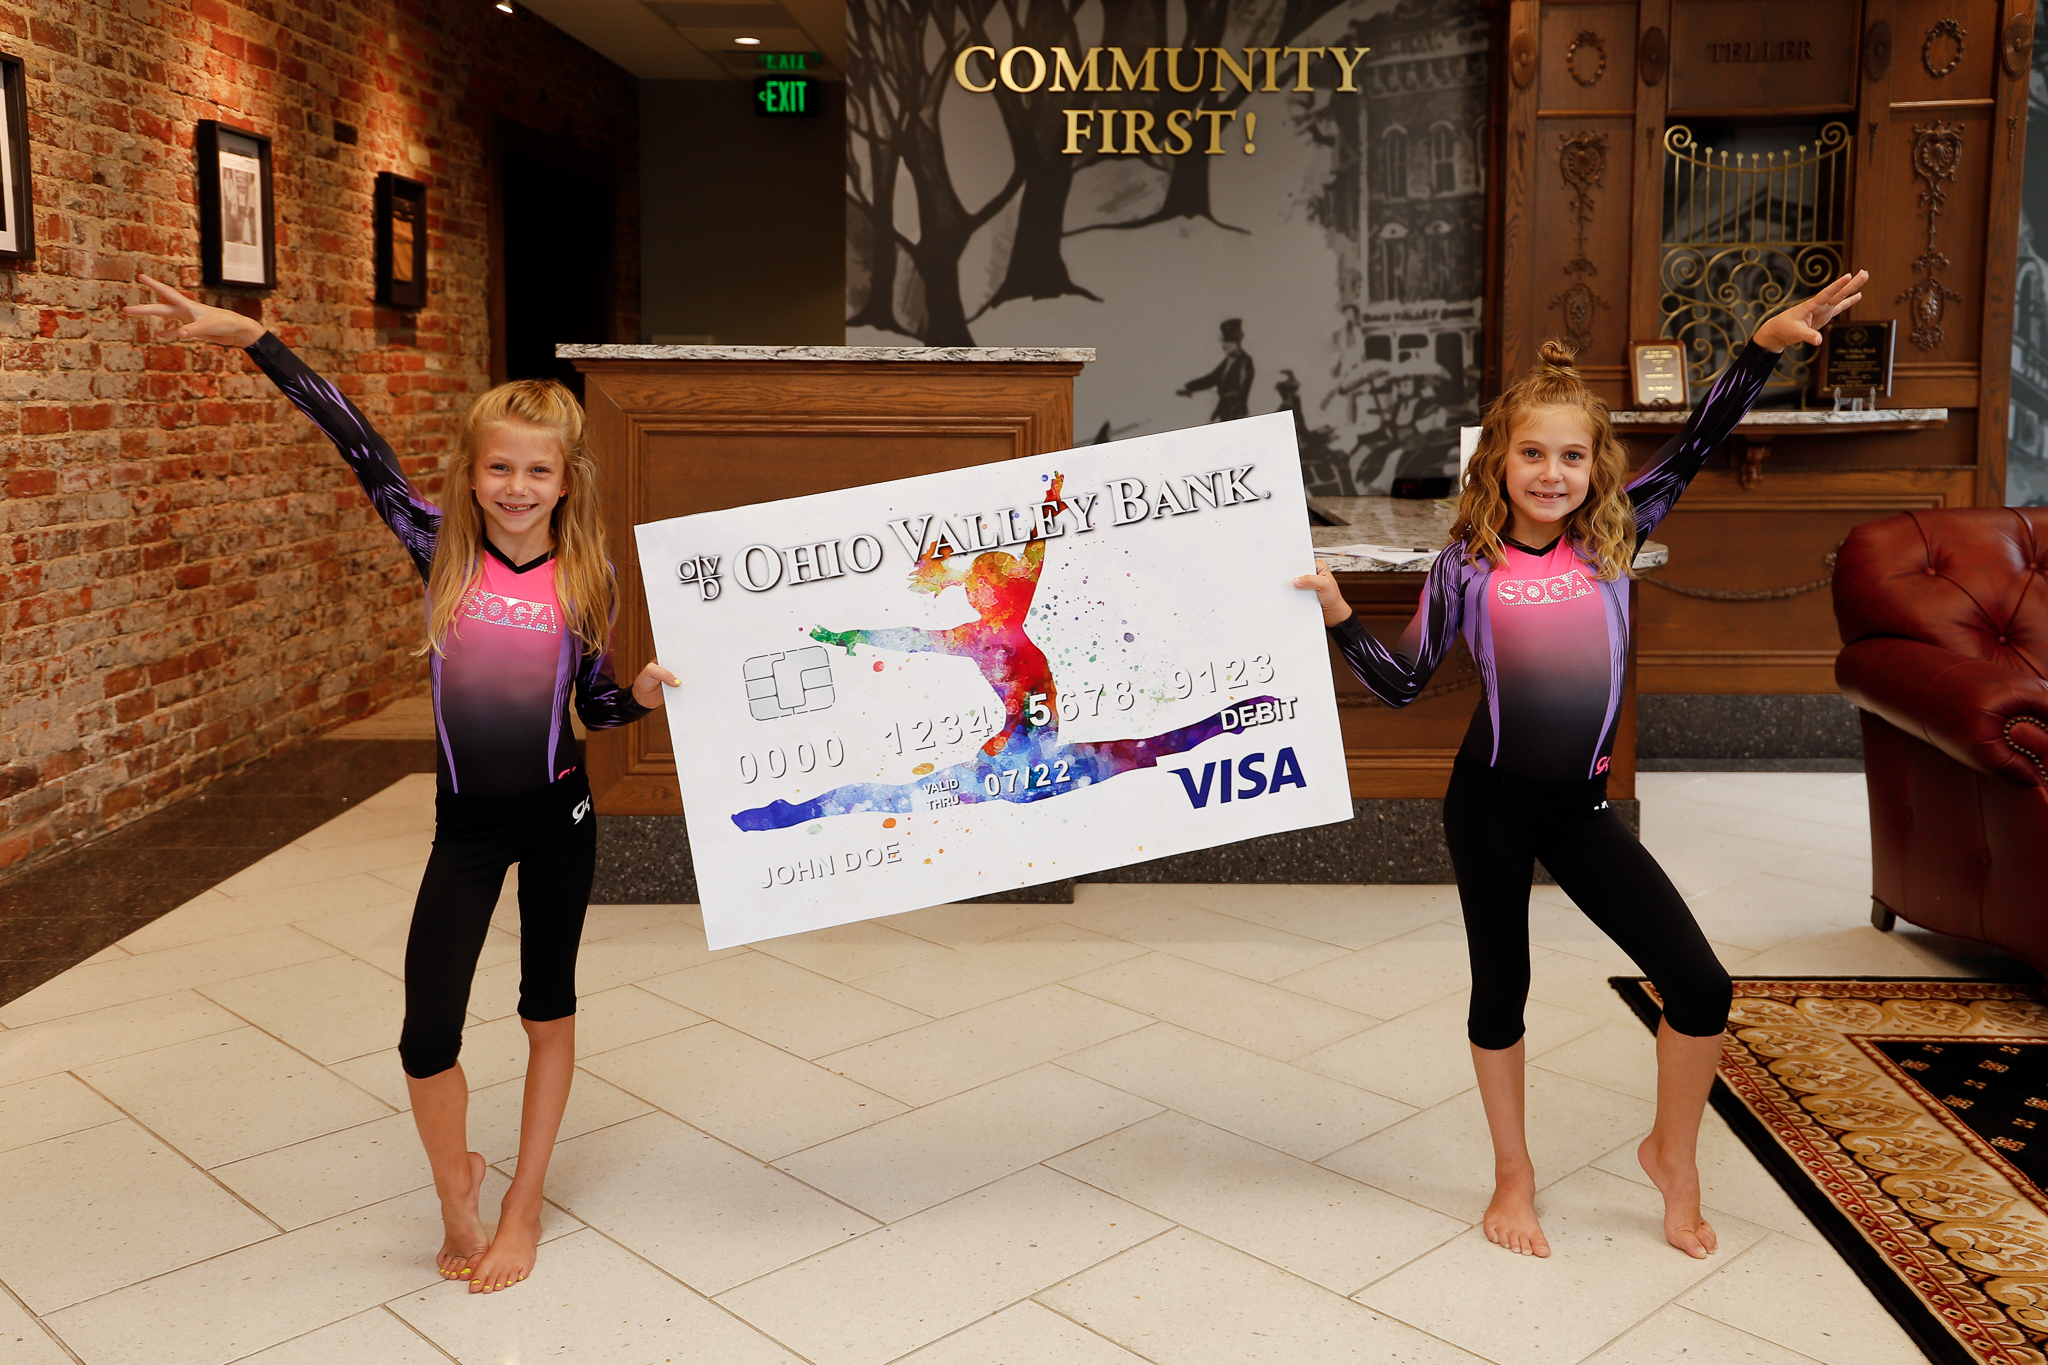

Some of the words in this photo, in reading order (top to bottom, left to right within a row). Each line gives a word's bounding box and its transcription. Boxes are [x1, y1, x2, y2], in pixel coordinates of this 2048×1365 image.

[953, 45, 1372, 94] COMMUNITY
[1706, 40, 1814, 63] TELLER
[766, 80, 807, 112] EXIT
[1061, 108, 1257, 156] FIRST!
[733, 534, 883, 593] OHIO
[887, 493, 1097, 564] VALLEY
[1498, 570, 1594, 605] SOGA
[462, 589, 556, 633] SOGA
[739, 735, 844, 784] 0000
[885, 706, 993, 755] 1234
[1029, 680, 1135, 727] 5678
[1173, 652, 1275, 700] 9123
[1220, 696, 1298, 731] DEBIT
[922, 778, 960, 795] VALID
[984, 759, 1072, 797] 07/22
[1167, 746, 1307, 809] VISA
[926, 794, 960, 811] THRU
[760, 855, 836, 889] JOHN
[845, 842, 903, 873] DOE
